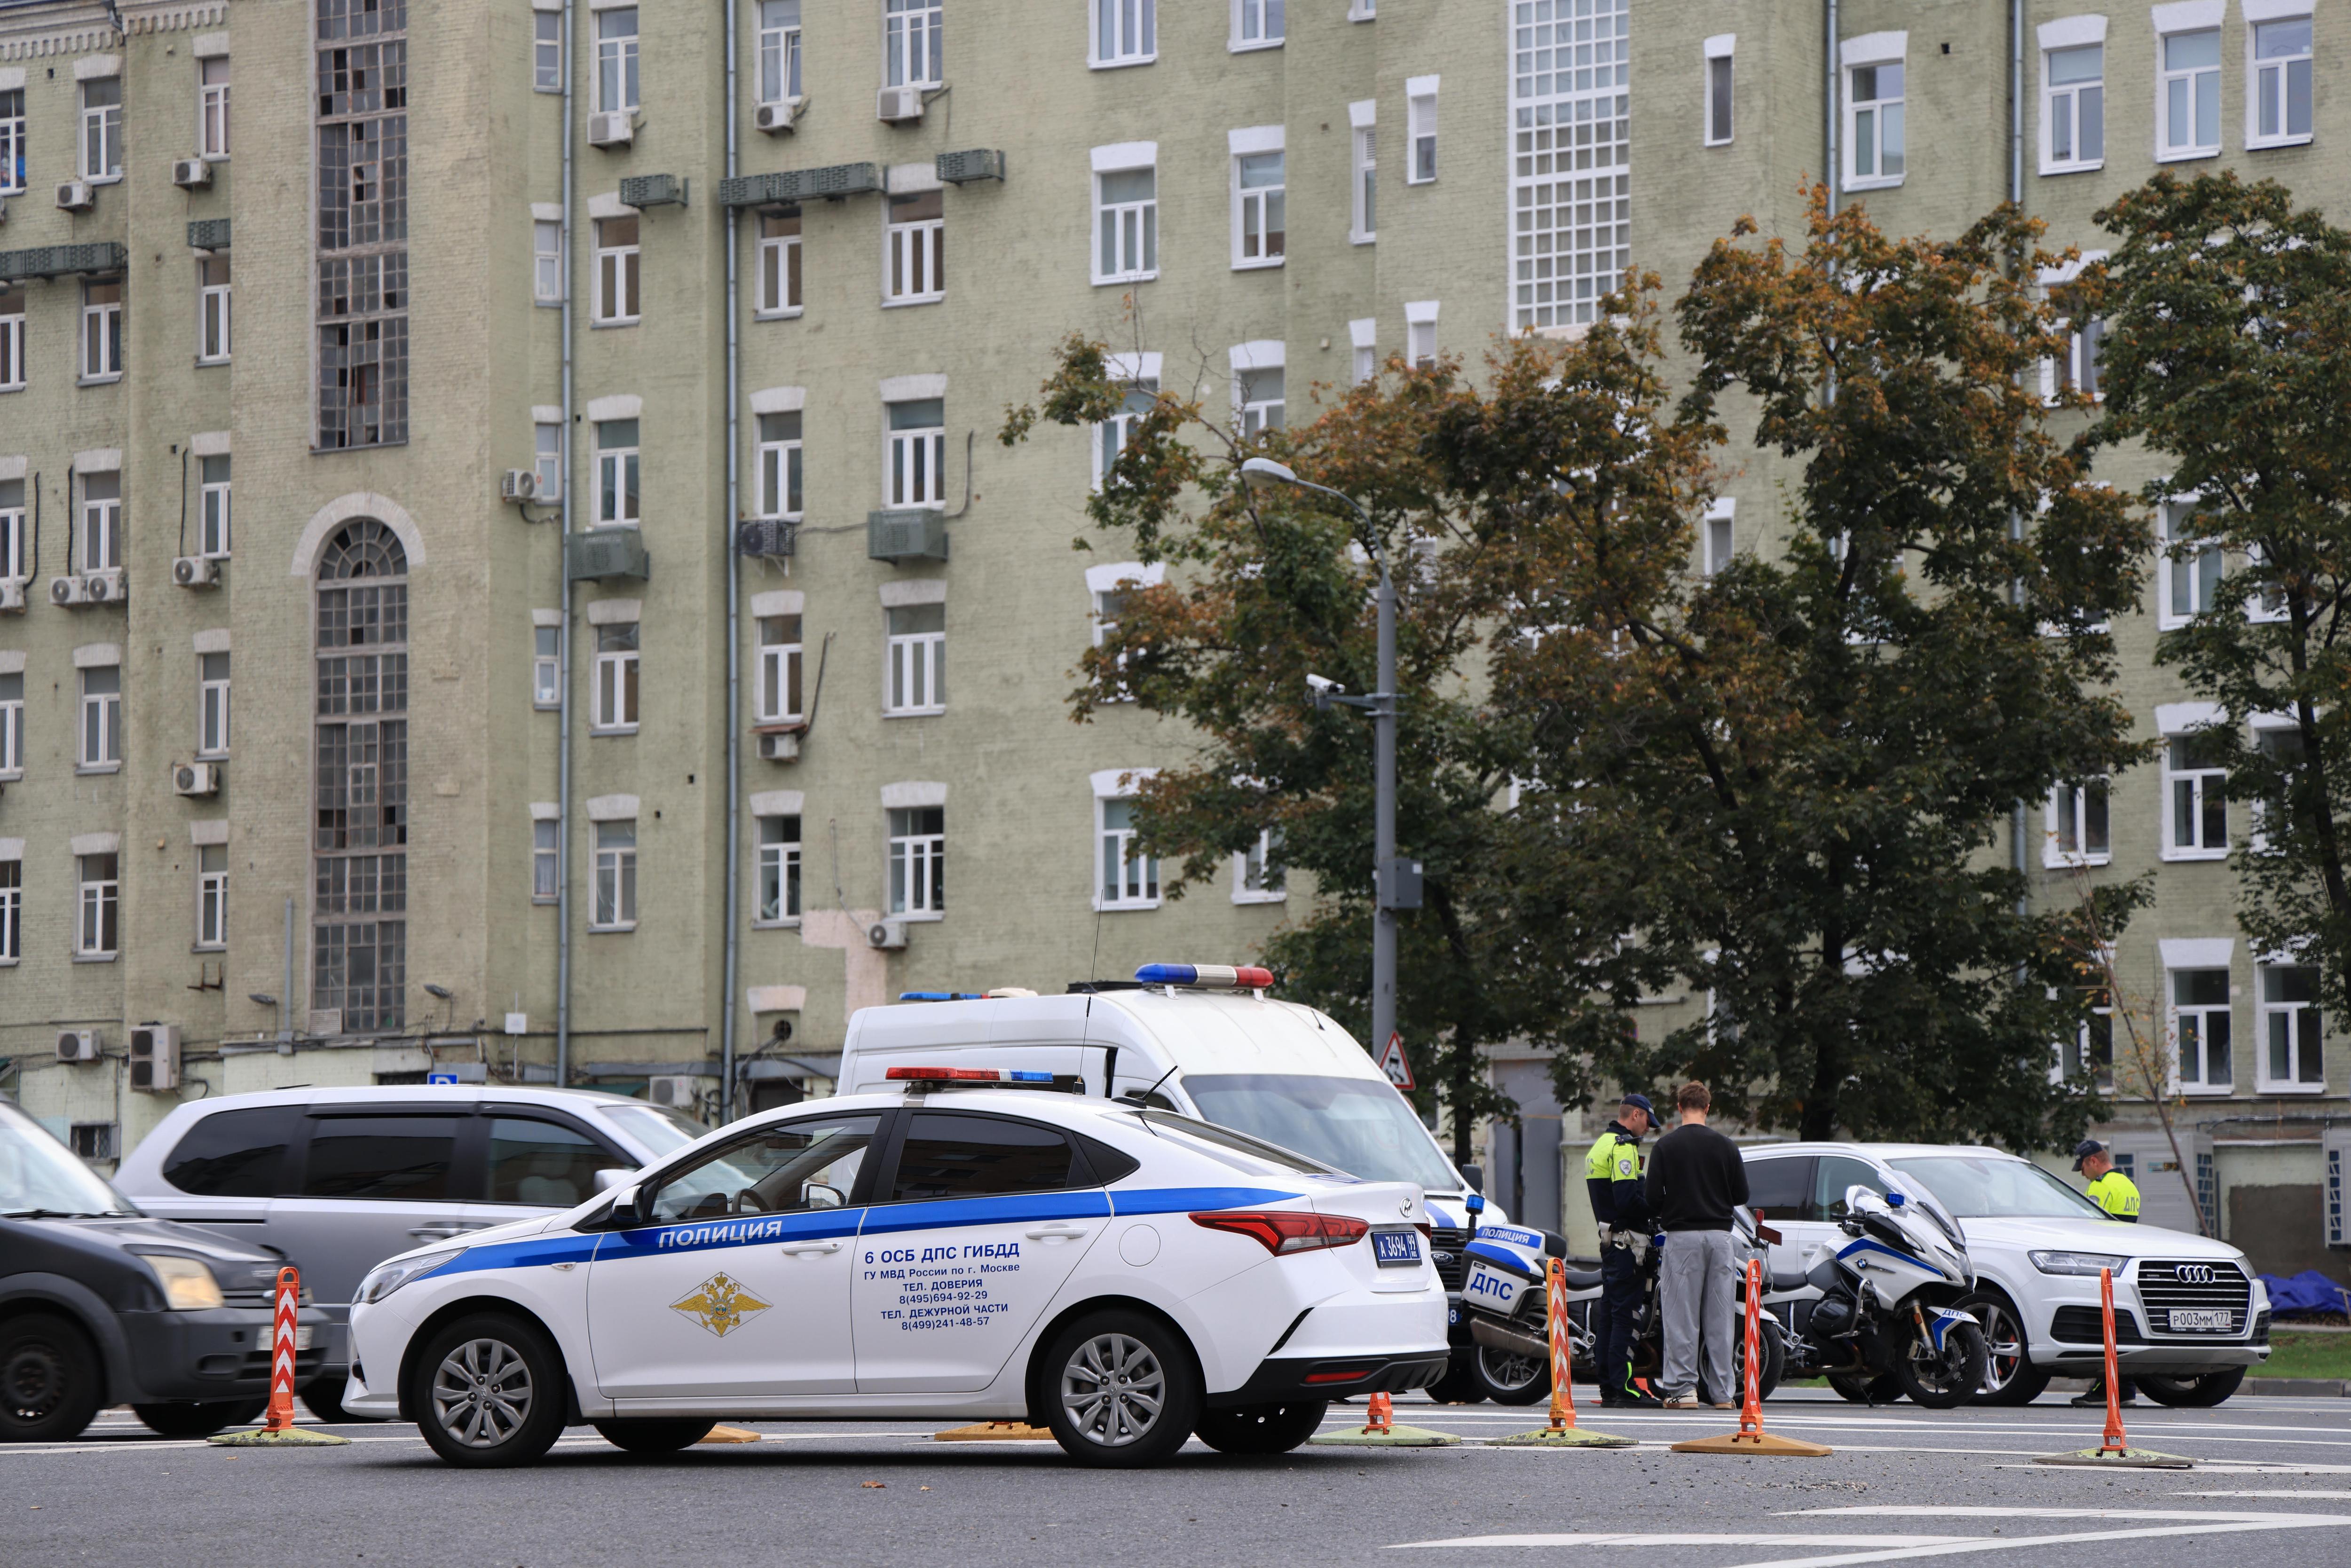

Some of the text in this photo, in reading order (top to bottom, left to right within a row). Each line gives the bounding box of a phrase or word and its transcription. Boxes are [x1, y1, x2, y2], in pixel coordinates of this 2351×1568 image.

[659, 1221, 782, 1248] ПОЛИЦИЯ
[1482, 1228, 1530, 1244] ПОЛИЦИЯ
[865, 1243, 1019, 1264] 6 ОСБ ДПС ГИБДД
[1380, 1235, 1416, 1257] А 3694 99
[1433, 1254, 1449, 1263] Ford
[864, 1271, 876, 1280] ГУ
[880, 1270, 905, 1279] МВД
[909, 1269, 947, 1277] России
[981, 1264, 1020, 1273] Москве
[903, 1279, 983, 1292] ТЕЛ. ДОВЕРИЯ
[1470, 1272, 1513, 1300] ДПС
[899, 1291, 987, 1305] 8(495)694-92-29
[881, 1303, 1008, 1319] ТЕЛ. ДЕЖУРНОЙ ЧАСТИ
[1942, 1309, 1967, 1319] ДПС
[2214, 1312, 2229, 1322] 177
[902, 1317, 990, 1332] 8(499)241-48-57
